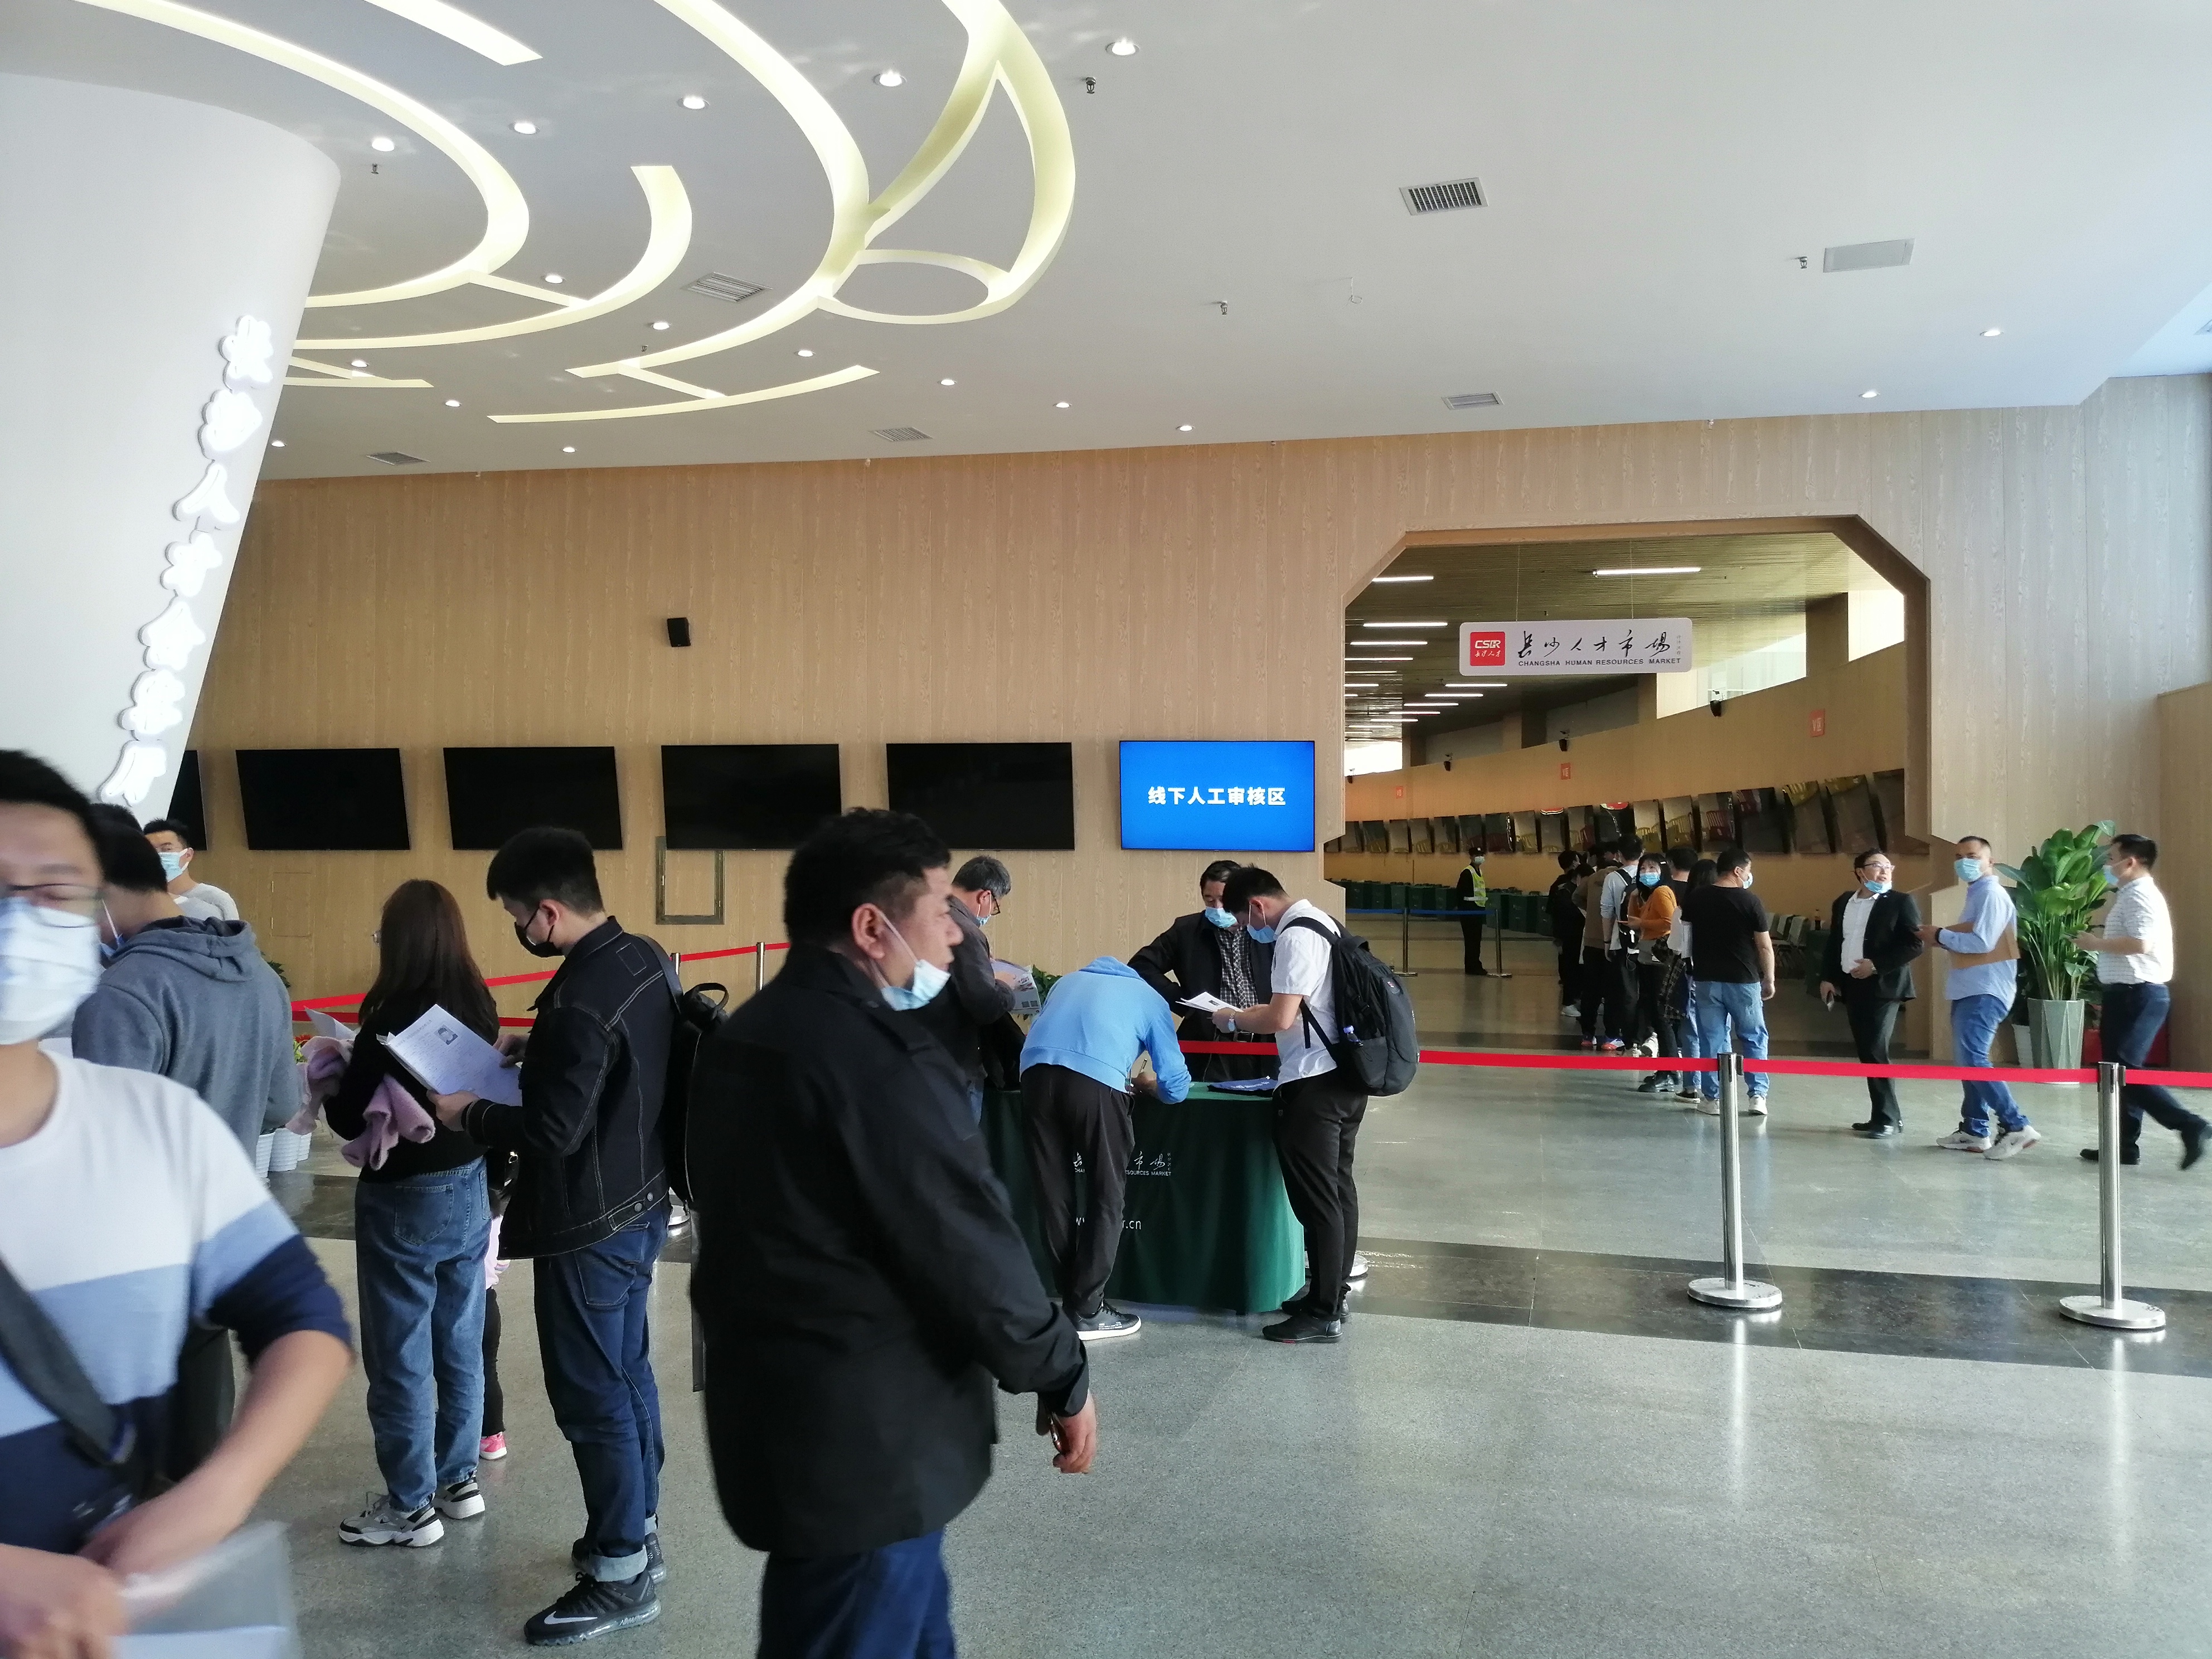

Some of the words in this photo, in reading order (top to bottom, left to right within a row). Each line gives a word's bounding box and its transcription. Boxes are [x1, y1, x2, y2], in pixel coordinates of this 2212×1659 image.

[1148, 786, 1286, 806] 线下人工审核区
